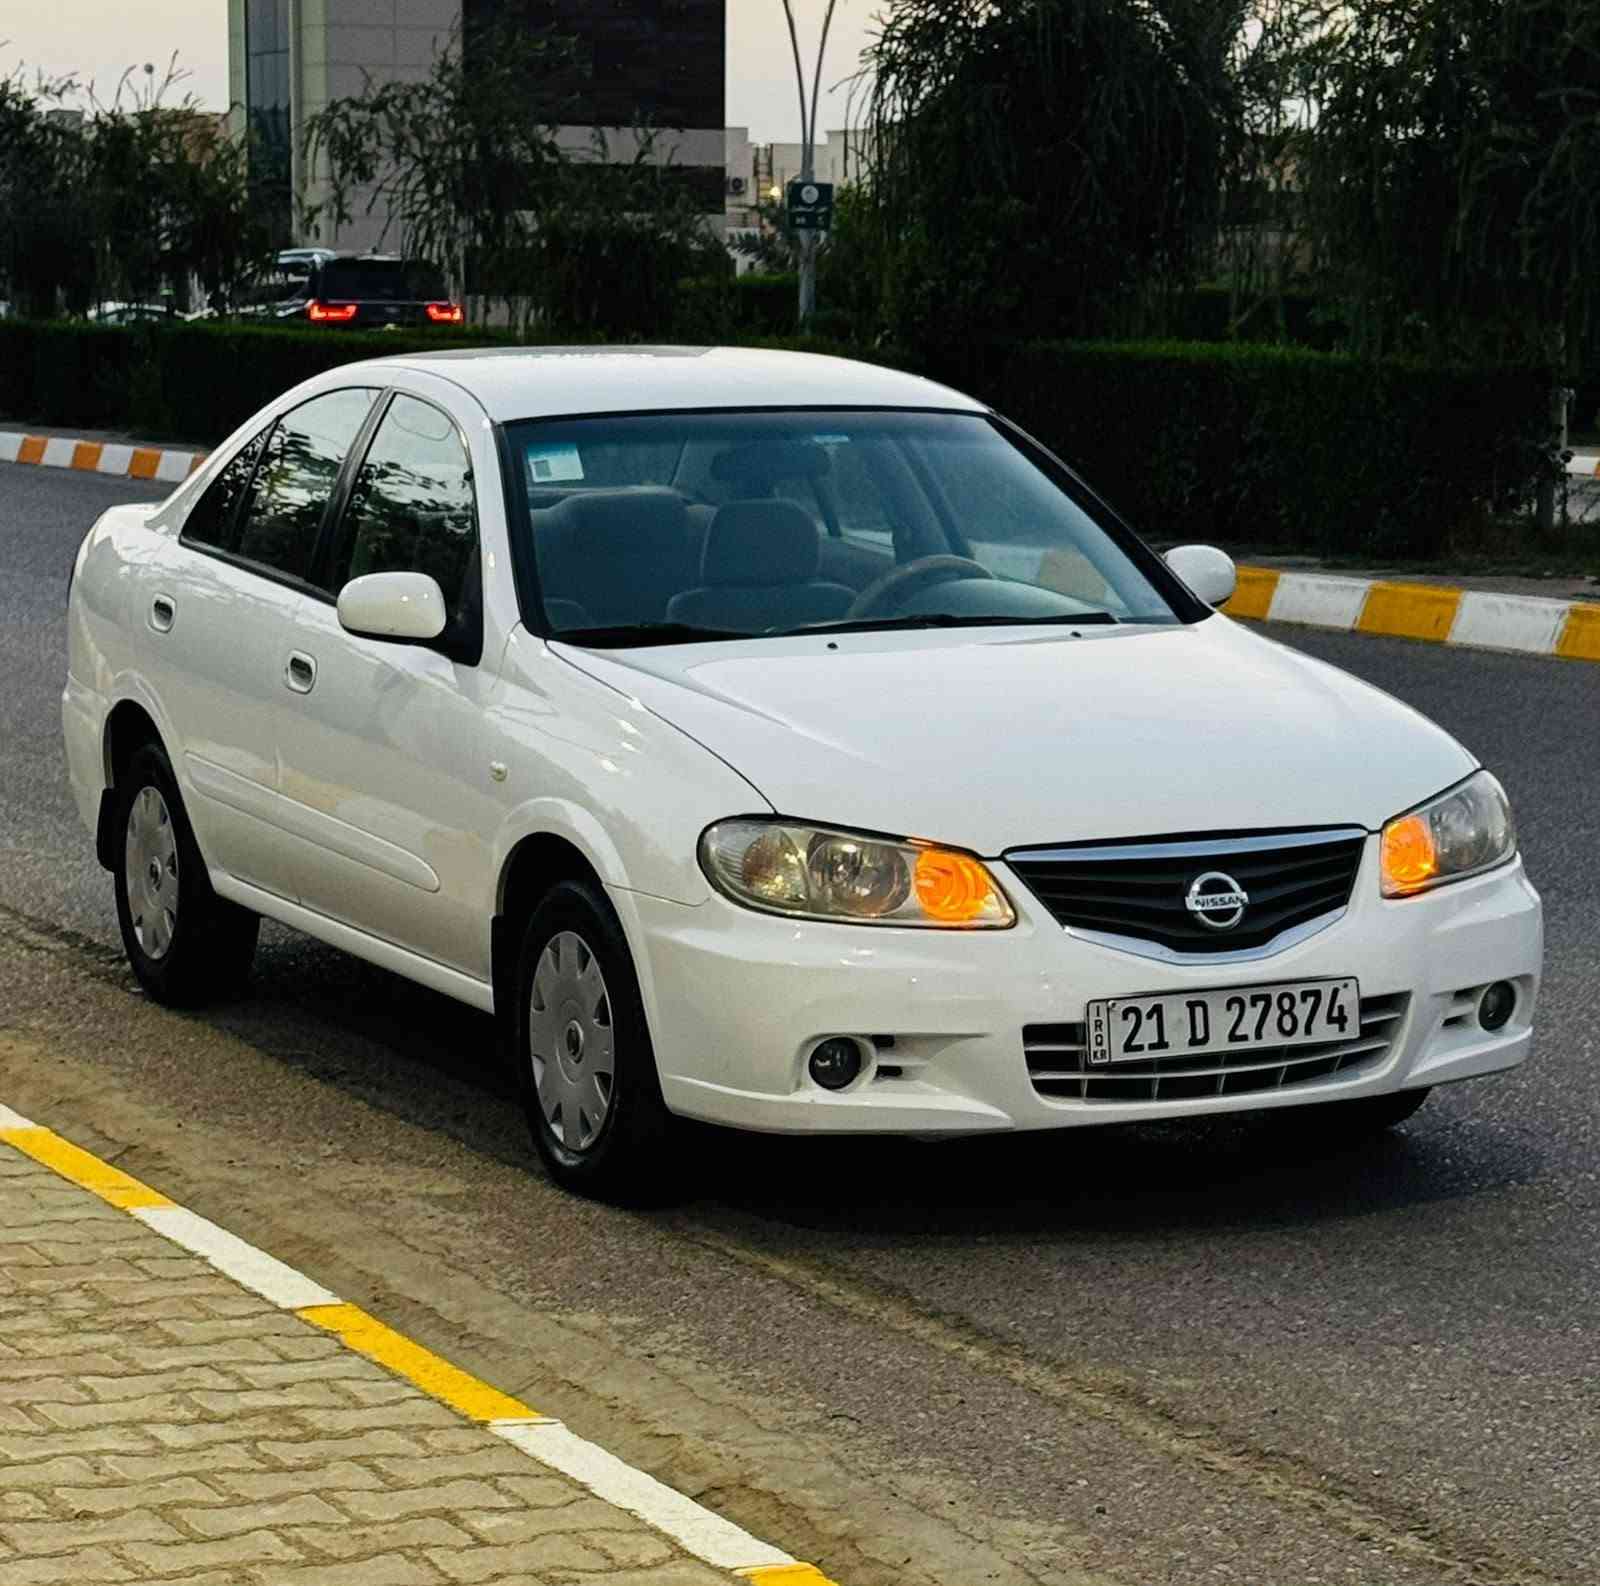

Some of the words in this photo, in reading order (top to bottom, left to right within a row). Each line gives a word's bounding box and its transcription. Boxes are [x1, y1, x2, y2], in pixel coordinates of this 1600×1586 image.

[1194, 895, 1245, 908] NISSAN
[1121, 1003, 1169, 1053] 21
[1186, 1000, 1210, 1047] D
[1226, 987, 1348, 1042] 27874
